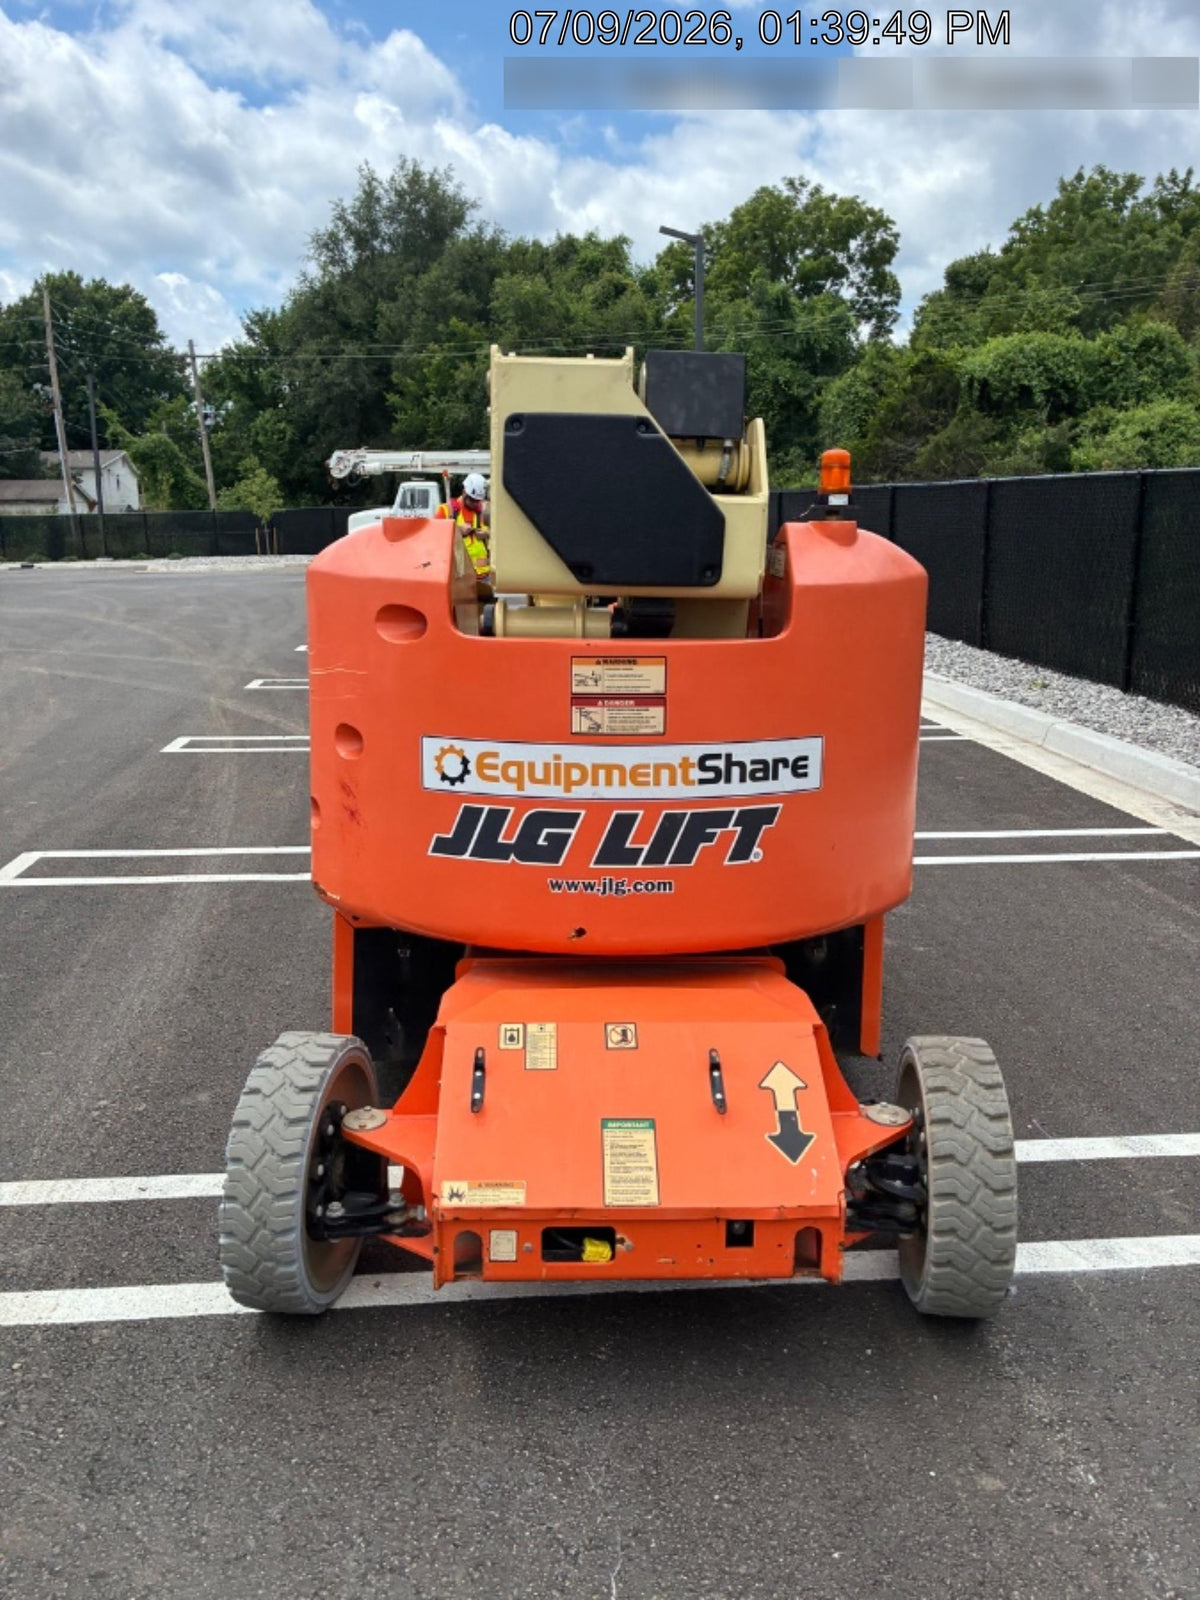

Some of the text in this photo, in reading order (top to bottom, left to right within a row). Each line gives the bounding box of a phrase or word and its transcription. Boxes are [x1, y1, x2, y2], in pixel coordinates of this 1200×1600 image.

[475, 750, 809, 793] EquipmentShare
[427, 803, 585, 866] JLG
[548, 877, 674, 895] www.jlg.com
